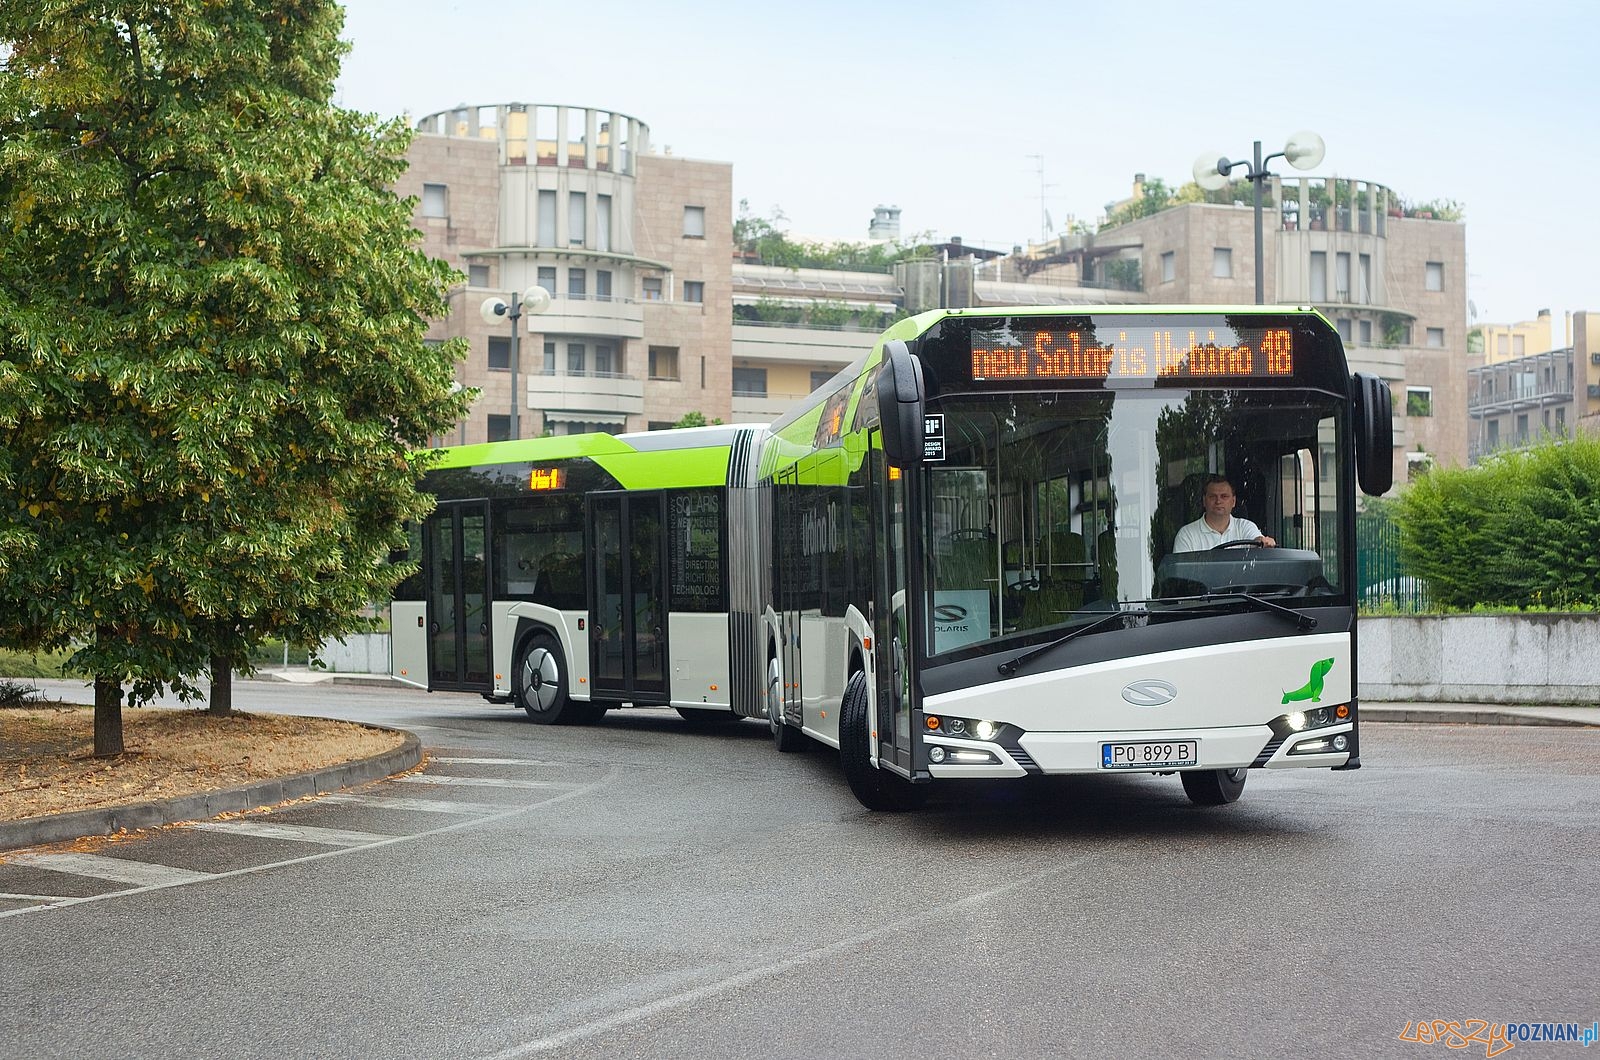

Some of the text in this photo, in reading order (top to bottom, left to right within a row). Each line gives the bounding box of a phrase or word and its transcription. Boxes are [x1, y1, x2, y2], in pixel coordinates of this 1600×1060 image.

[972, 330, 1291, 377] new Solaris Urbino 18
[676, 495, 719, 513] SOLARIS
[803, 507, 827, 556] Urbino
[828, 501, 837, 553] 18
[686, 560, 719, 569] DIRECTION
[686, 573, 719, 583] RICHTUNG
[672, 584, 720, 595] TECHNOLOGY
[934, 625, 969, 633] OLARIS
[1144, 745, 1173, 761] 899
[1178, 744, 1189, 760] B
